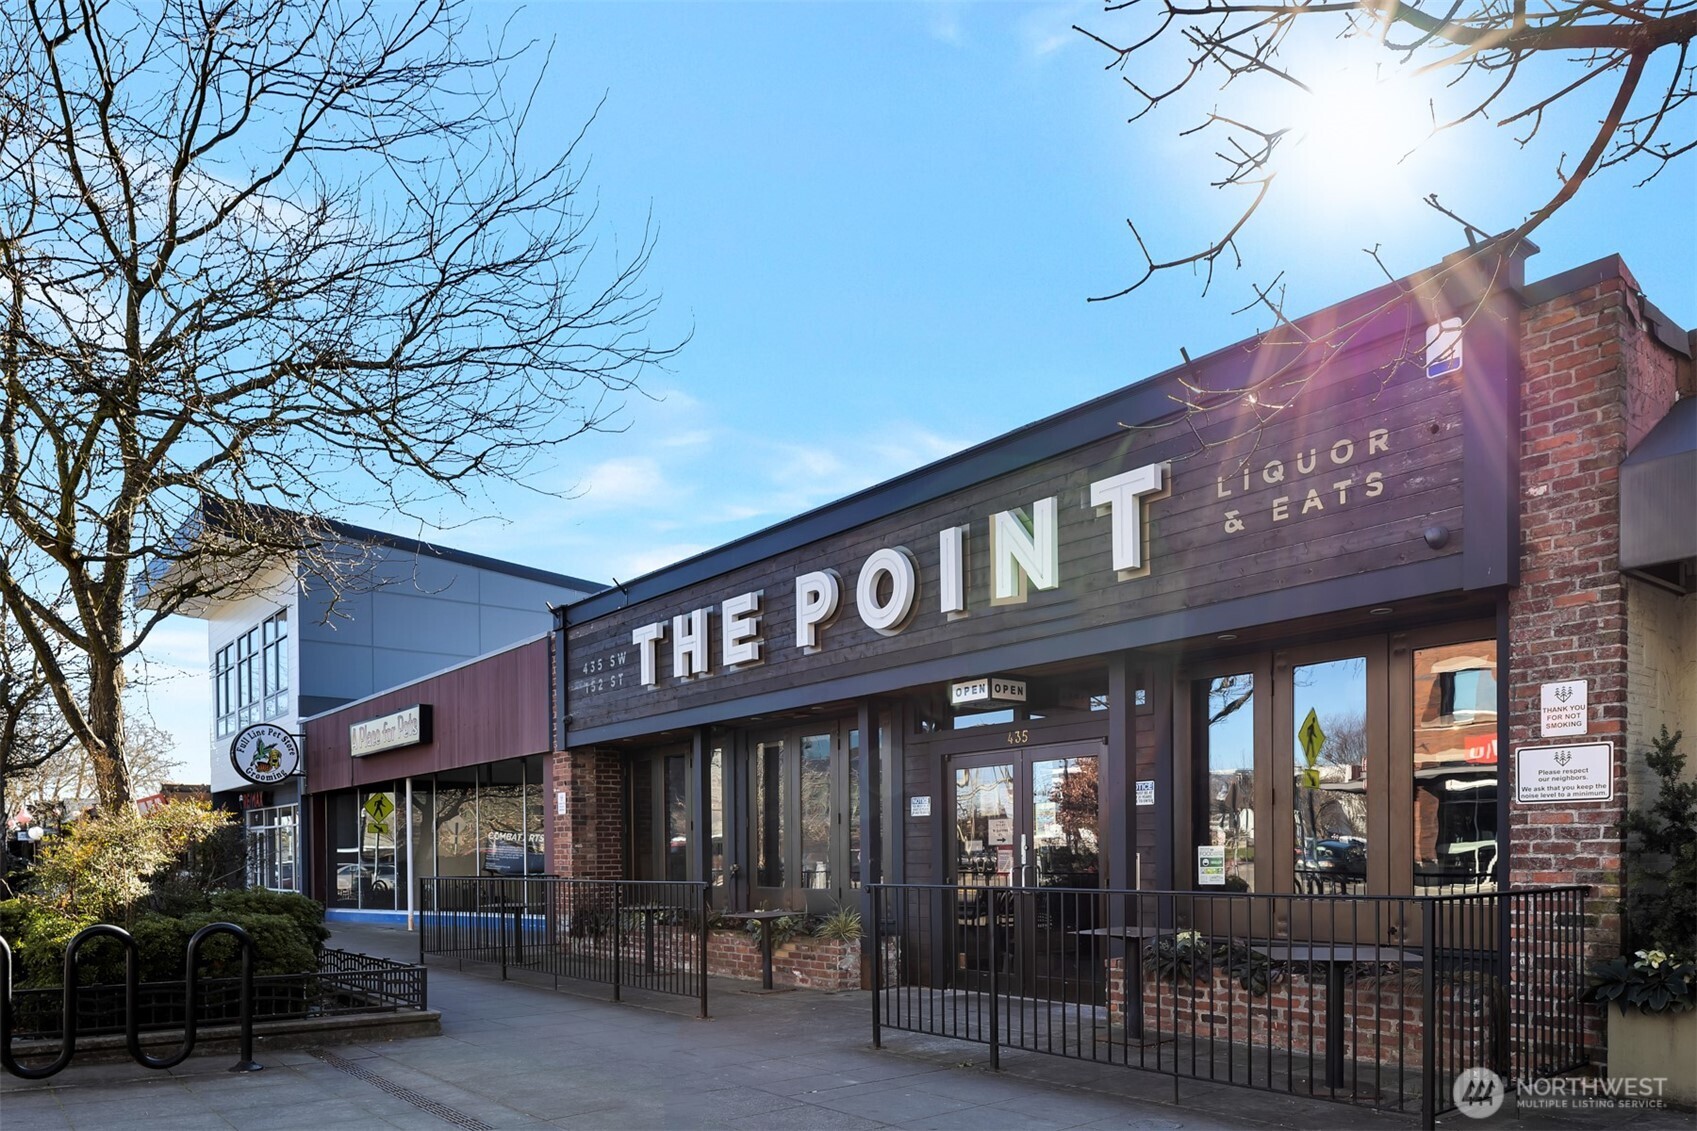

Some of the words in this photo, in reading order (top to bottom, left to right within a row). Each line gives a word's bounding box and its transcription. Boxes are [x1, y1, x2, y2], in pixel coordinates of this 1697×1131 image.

[1217, 428, 1389, 498] LIQUOR
[1224, 509, 1245, 534] &
[1273, 471, 1384, 522] EATS
[632, 589, 764, 690] THE
[795, 462, 1171, 656] POINT
[582, 658, 603, 675] 435
[609, 651, 627, 667] SW
[584, 678, 603, 694] 152
[610, 672, 624, 688] ST
[994, 683, 1024, 696] OPEN
[955, 683, 986, 698] OPEN
[1542, 706, 1568, 714] THANK
[1546, 713, 1563, 721] FOR
[1564, 712, 1581, 720] NOT
[1545, 720, 1583, 730] SMOKING
[359, 724, 381, 749] Place
[382, 721, 396, 744] for
[1006, 729, 1029, 745] 435
[236, 736, 251, 754] Full
[247, 729, 266, 740] Line
[267, 728, 282, 739] Pet
[280, 735, 296, 756] Store
[245, 767, 288, 781] Grooming
[1562, 767, 1589, 776] respect
[1551, 774, 1589, 783] neighbors.
[1136, 783, 1153, 791] TICE
[1572, 789, 1608, 797] minimum.
[1576, 783, 1594, 791] keep
[1595, 782, 1607, 790] the
[488, 831, 523, 841] COMBAT
[523, 833, 545, 842] RTS
